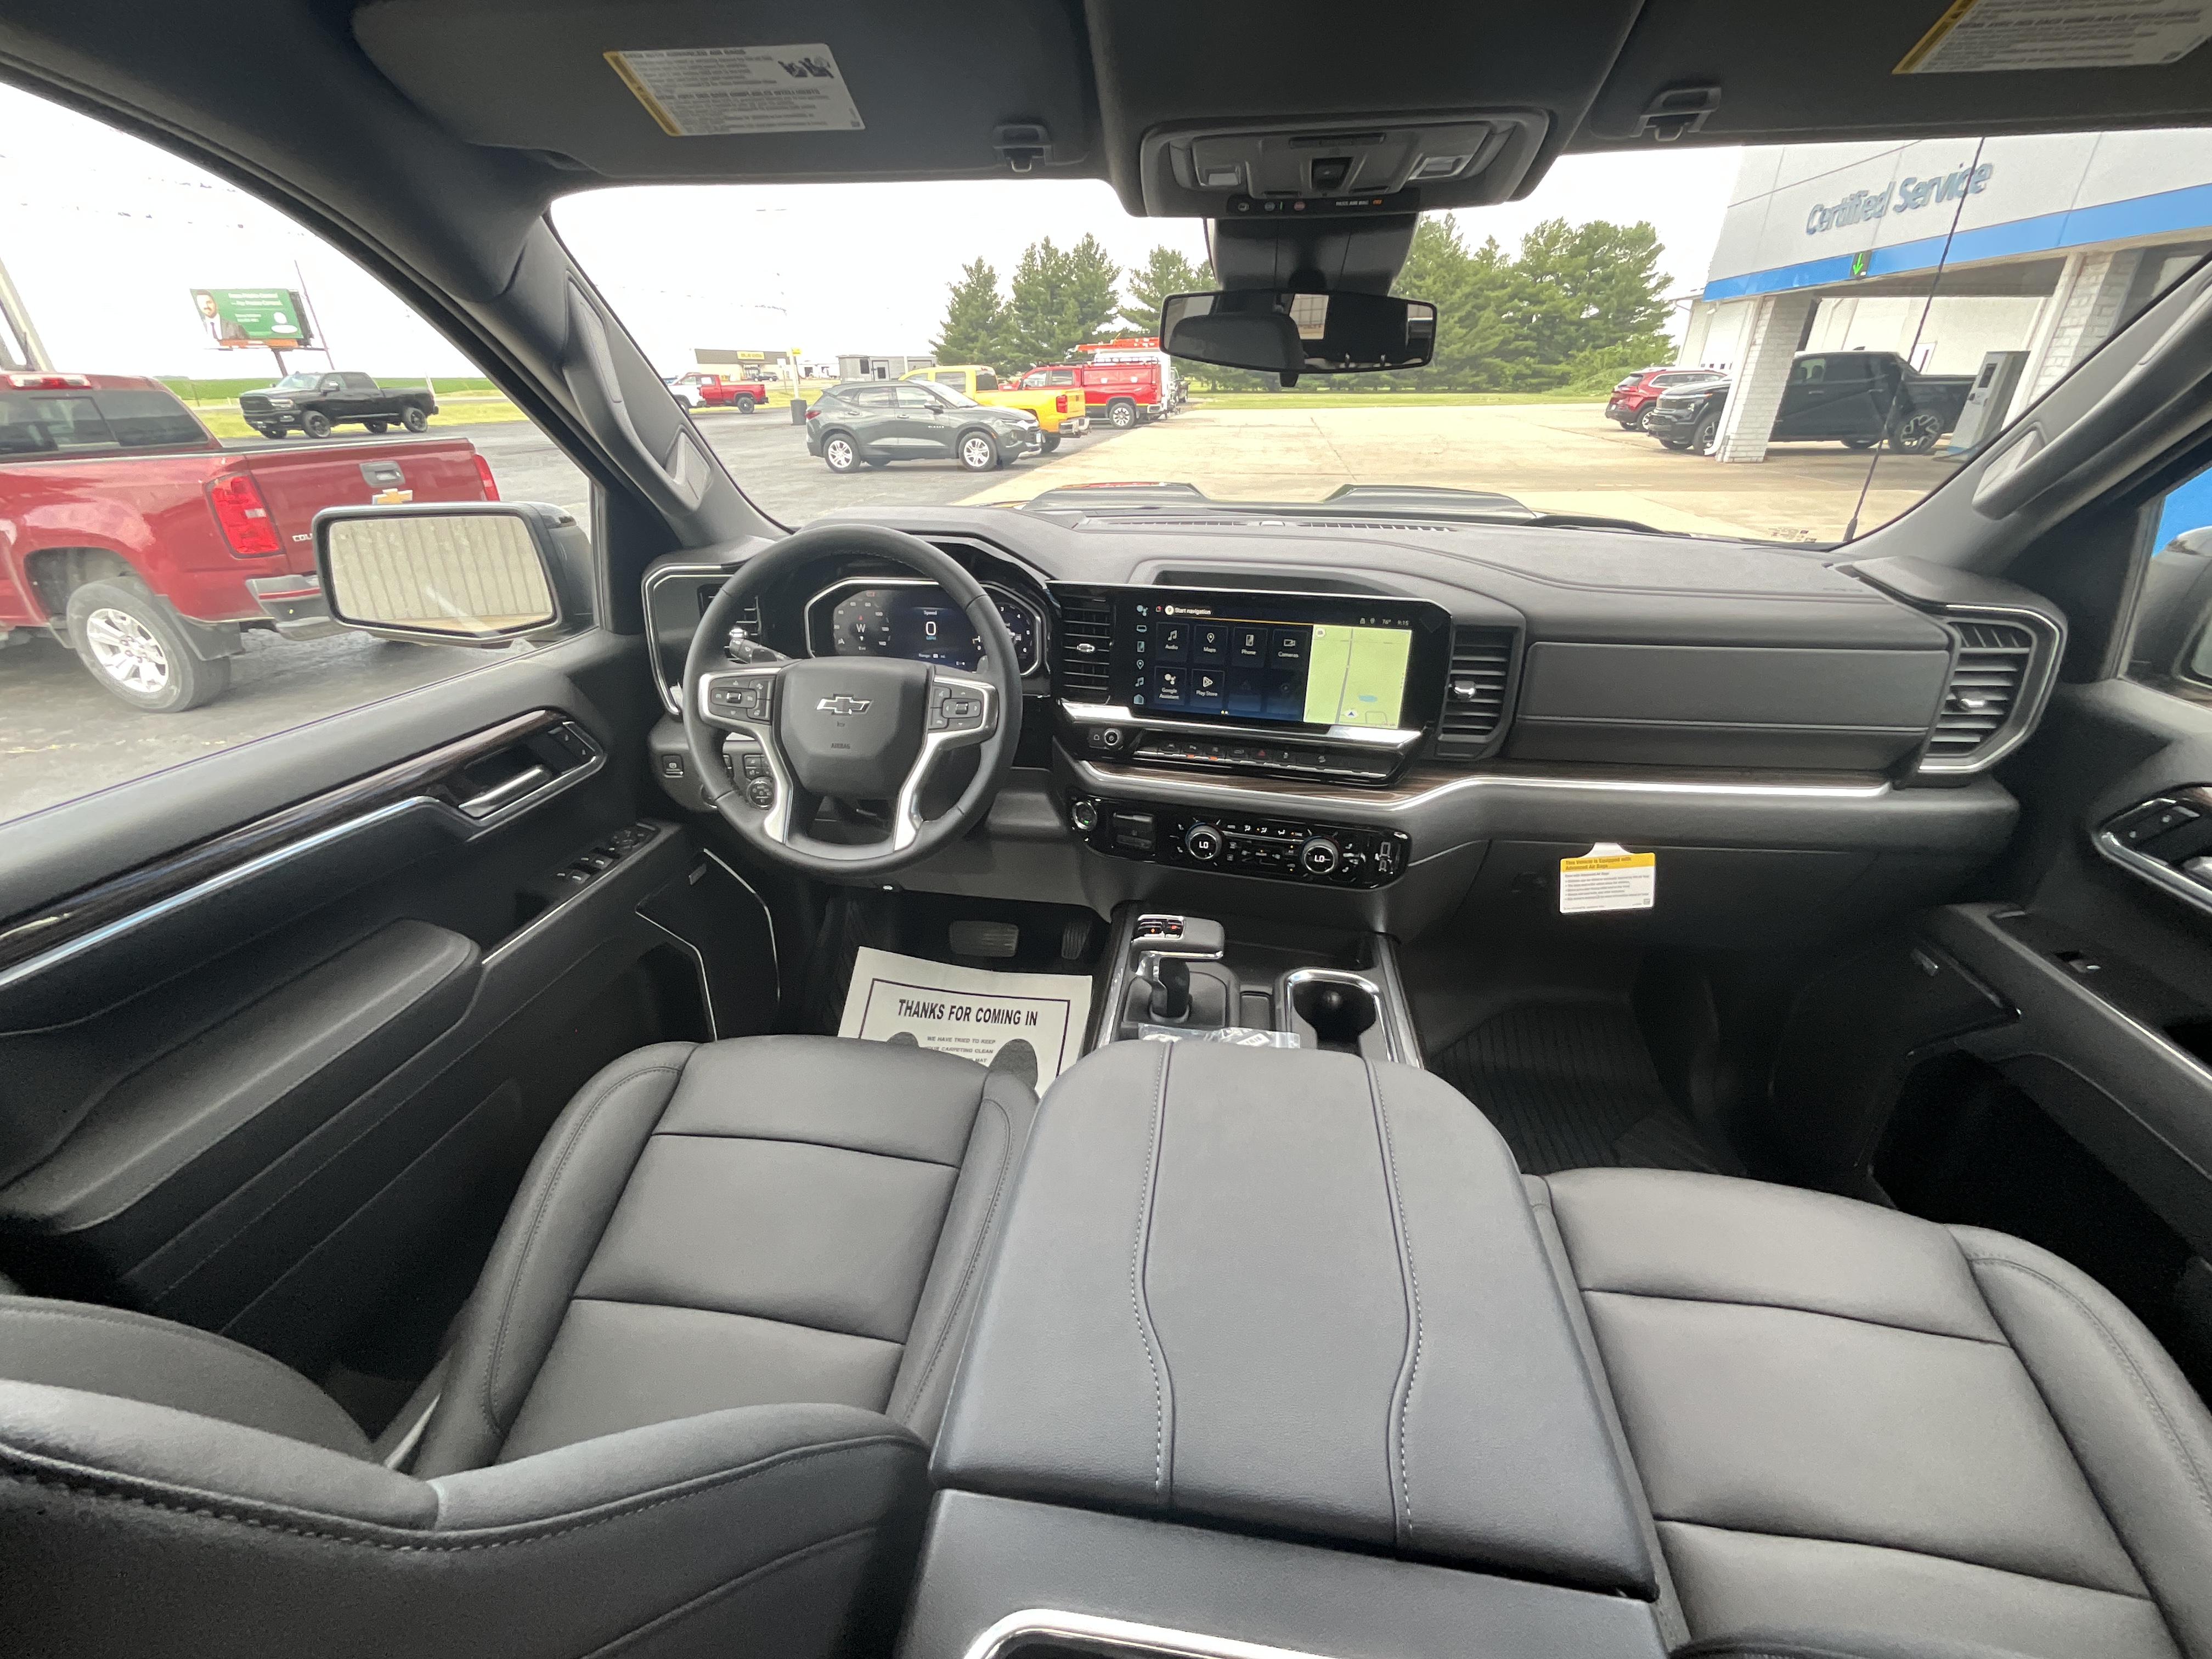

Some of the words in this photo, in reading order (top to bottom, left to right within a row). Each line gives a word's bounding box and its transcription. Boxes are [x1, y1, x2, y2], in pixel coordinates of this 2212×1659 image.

[1805, 180, 1897, 235] Certified
[1893, 162, 1994, 213] Service
[856, 623, 866, 633] W
[926, 621, 936, 635] 0
[1199, 841, 1209, 849] LO
[898, 998, 945, 1019] THANKS
[948, 1005, 972, 1022] FOR
[975, 1007, 1021, 1025] COMING
[1025, 1011, 1038, 1026] IN
